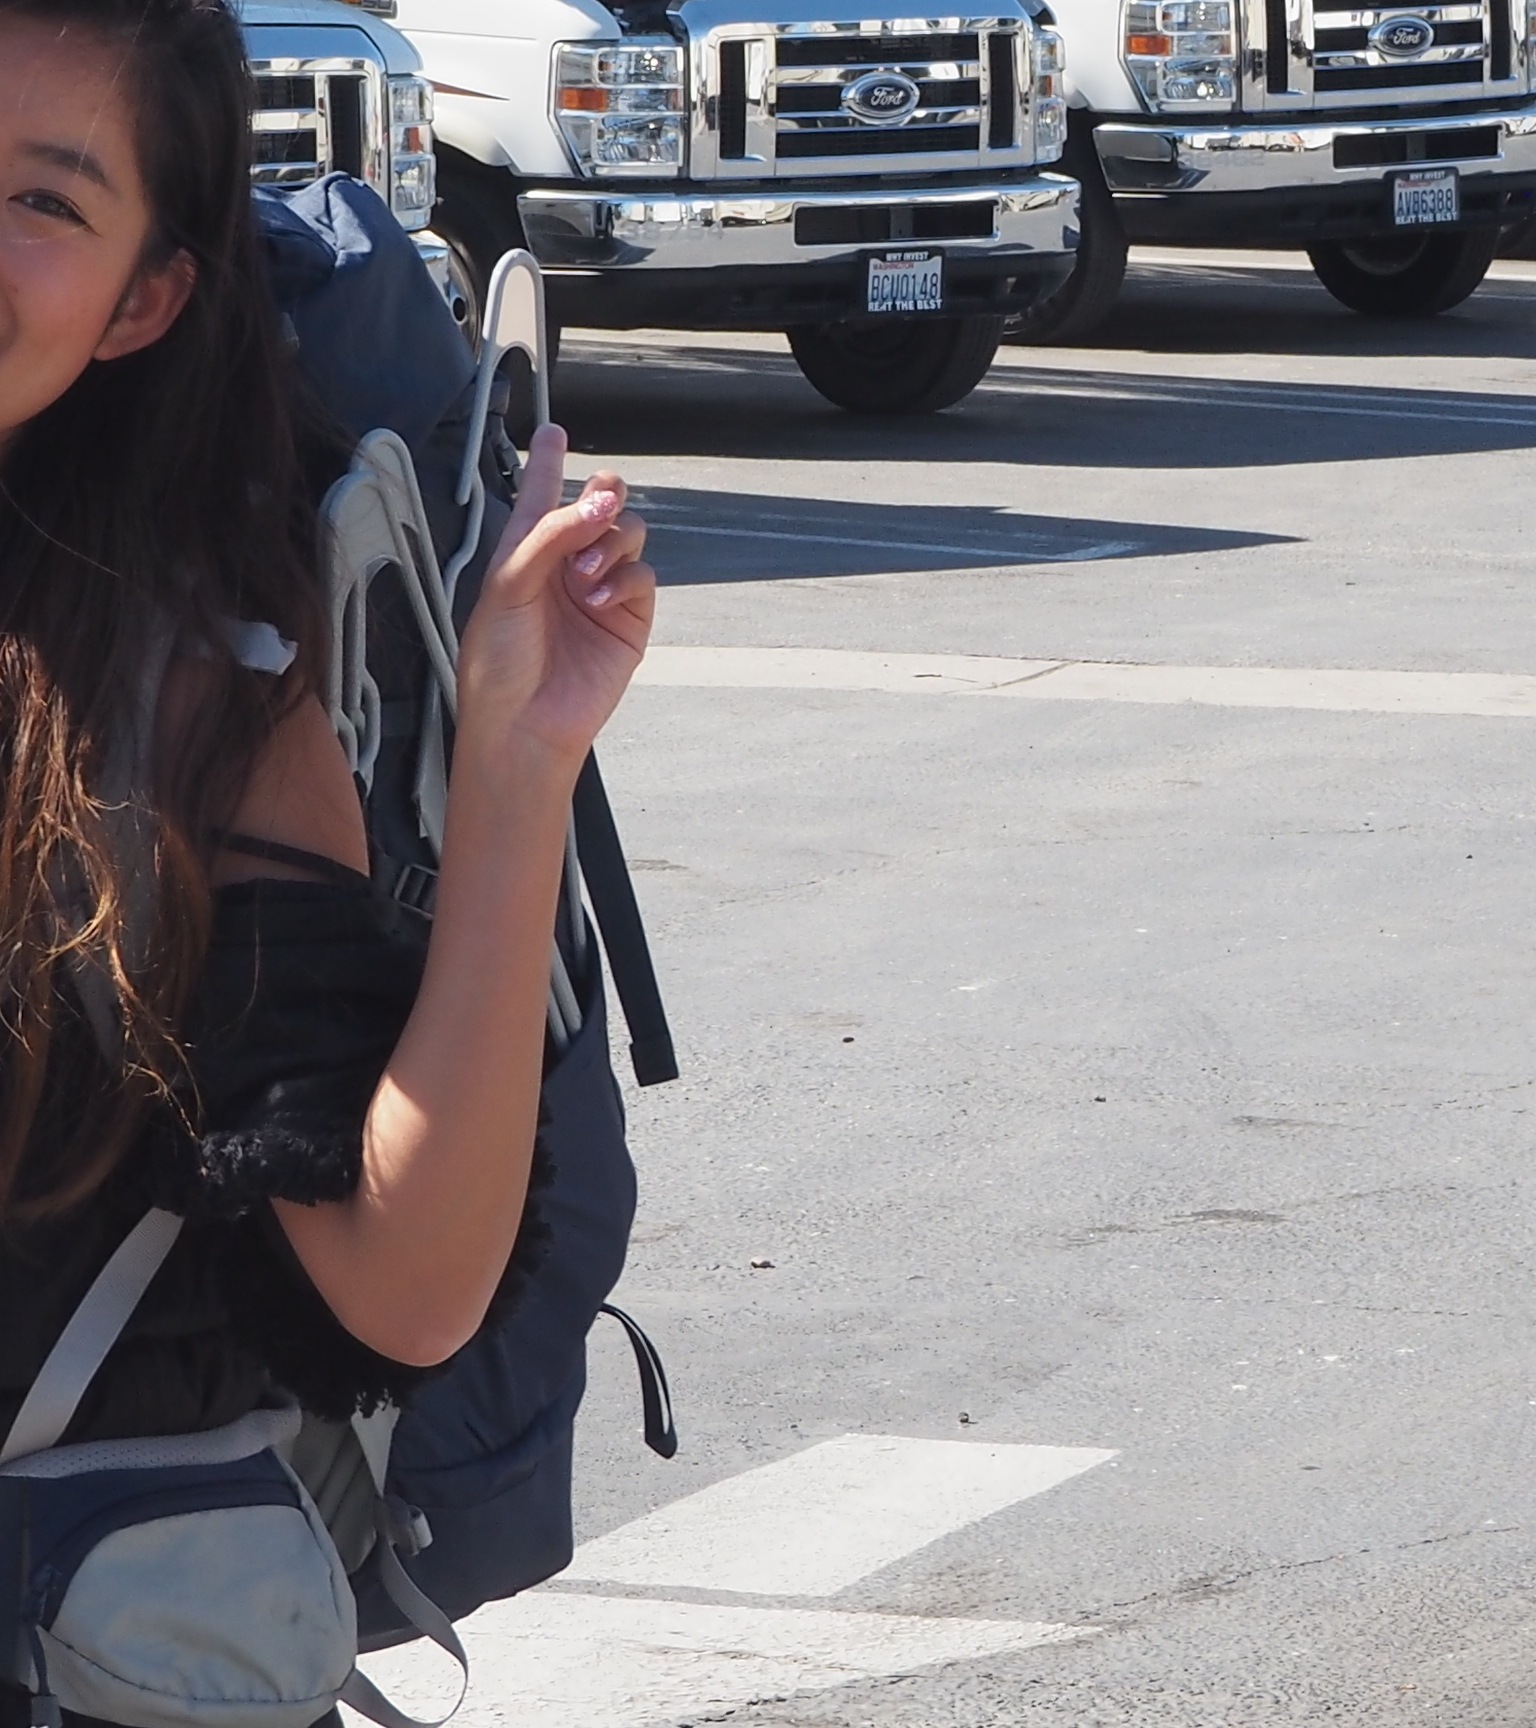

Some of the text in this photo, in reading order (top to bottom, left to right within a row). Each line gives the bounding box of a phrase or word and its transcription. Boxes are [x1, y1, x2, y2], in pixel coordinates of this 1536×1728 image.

[1393, 27, 1421, 45] Ford
[870, 86, 905, 106] Ford
[871, 273, 939, 301] BCU0148
[895, 301, 915, 311] THE
[916, 299, 942, 310] BEST
